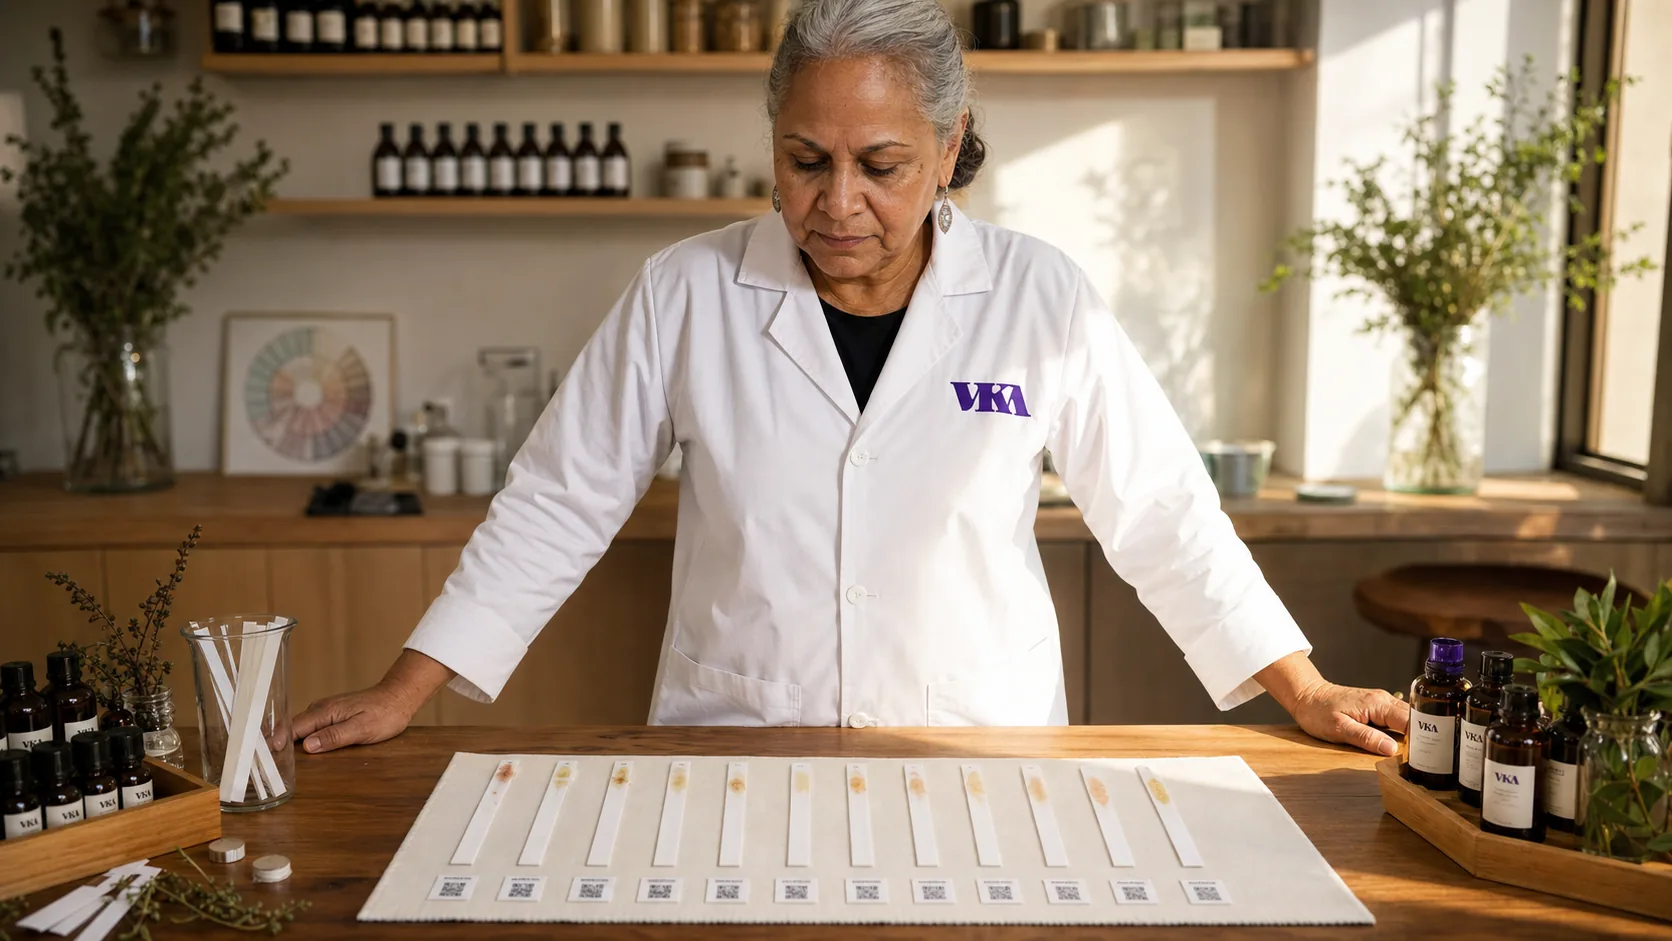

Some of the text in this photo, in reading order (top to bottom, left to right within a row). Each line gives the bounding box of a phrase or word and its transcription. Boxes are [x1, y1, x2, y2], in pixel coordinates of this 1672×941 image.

[950, 381, 1031, 417] VKA
[1418, 720, 1438, 733] VKA
[1465, 730, 1483, 743] VKA
[1495, 772, 1519, 785] VKA
